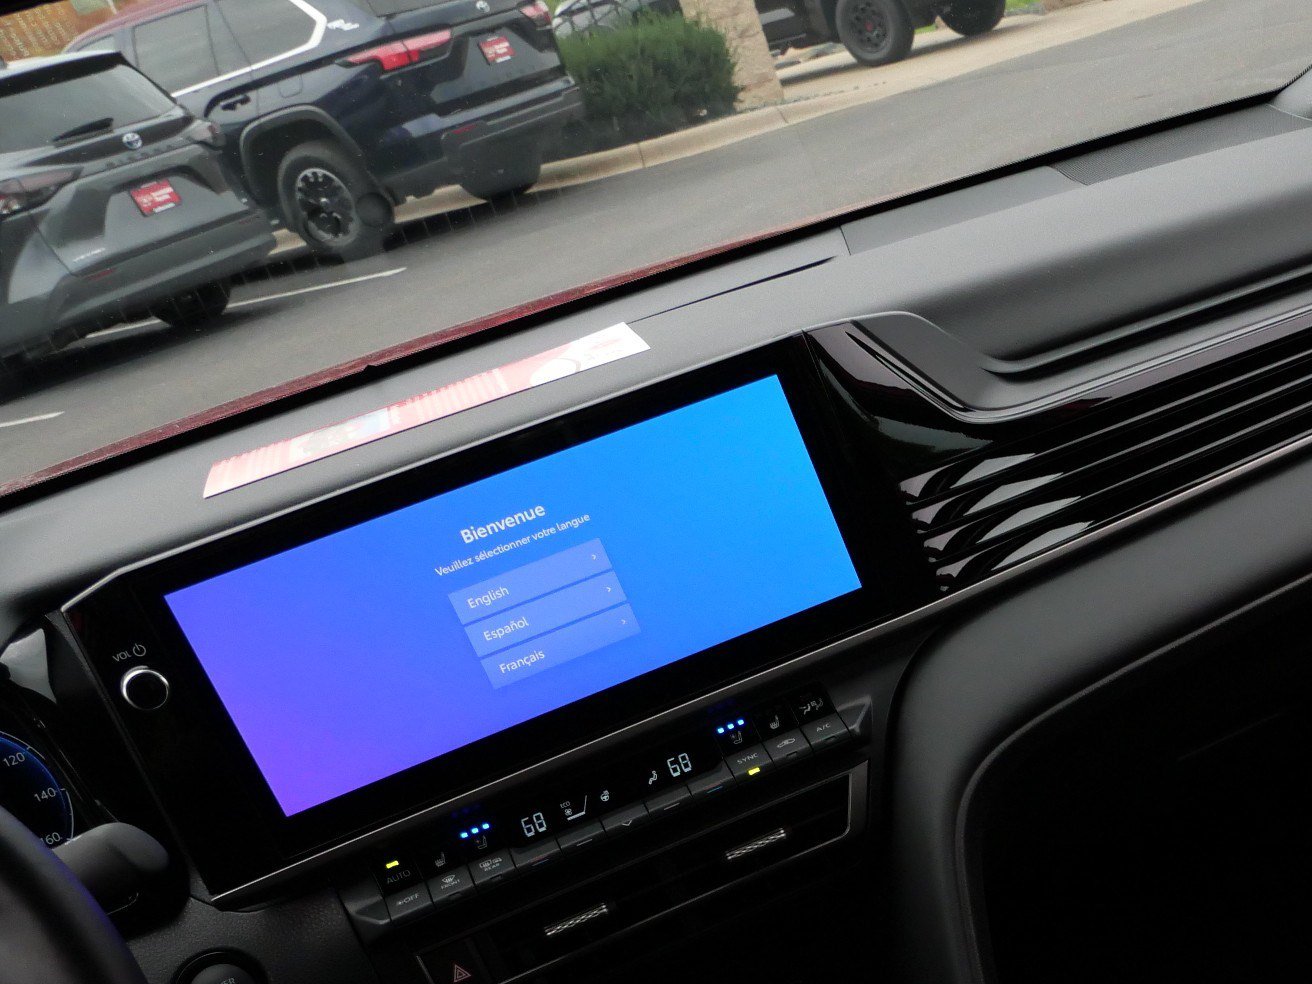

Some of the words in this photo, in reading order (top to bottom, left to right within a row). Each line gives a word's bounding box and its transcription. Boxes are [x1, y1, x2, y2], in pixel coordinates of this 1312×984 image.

[460, 505, 546, 544] Bienvenue
[434, 557, 474, 577] Veuillez
[474, 535, 531, 563] sélectionner
[531, 526, 557, 541] votre
[556, 514, 591, 532] langue
[467, 587, 510, 609] English
[483, 617, 529, 641] Español
[112, 650, 132, 662] VOL
[499, 650, 545, 674] Français
[816, 723, 831, 732] A/C
[3, 752, 26, 767] 120
[667, 753, 692, 778] 68
[737, 752, 758, 765] SYNC
[34, 787, 57, 802] 140
[560, 800, 571, 809] ECO
[521, 812, 547, 838] 68
[387, 869, 411, 885] AUTO
[441, 879, 461, 890] FRONT
[403, 893, 420, 904] OFF
